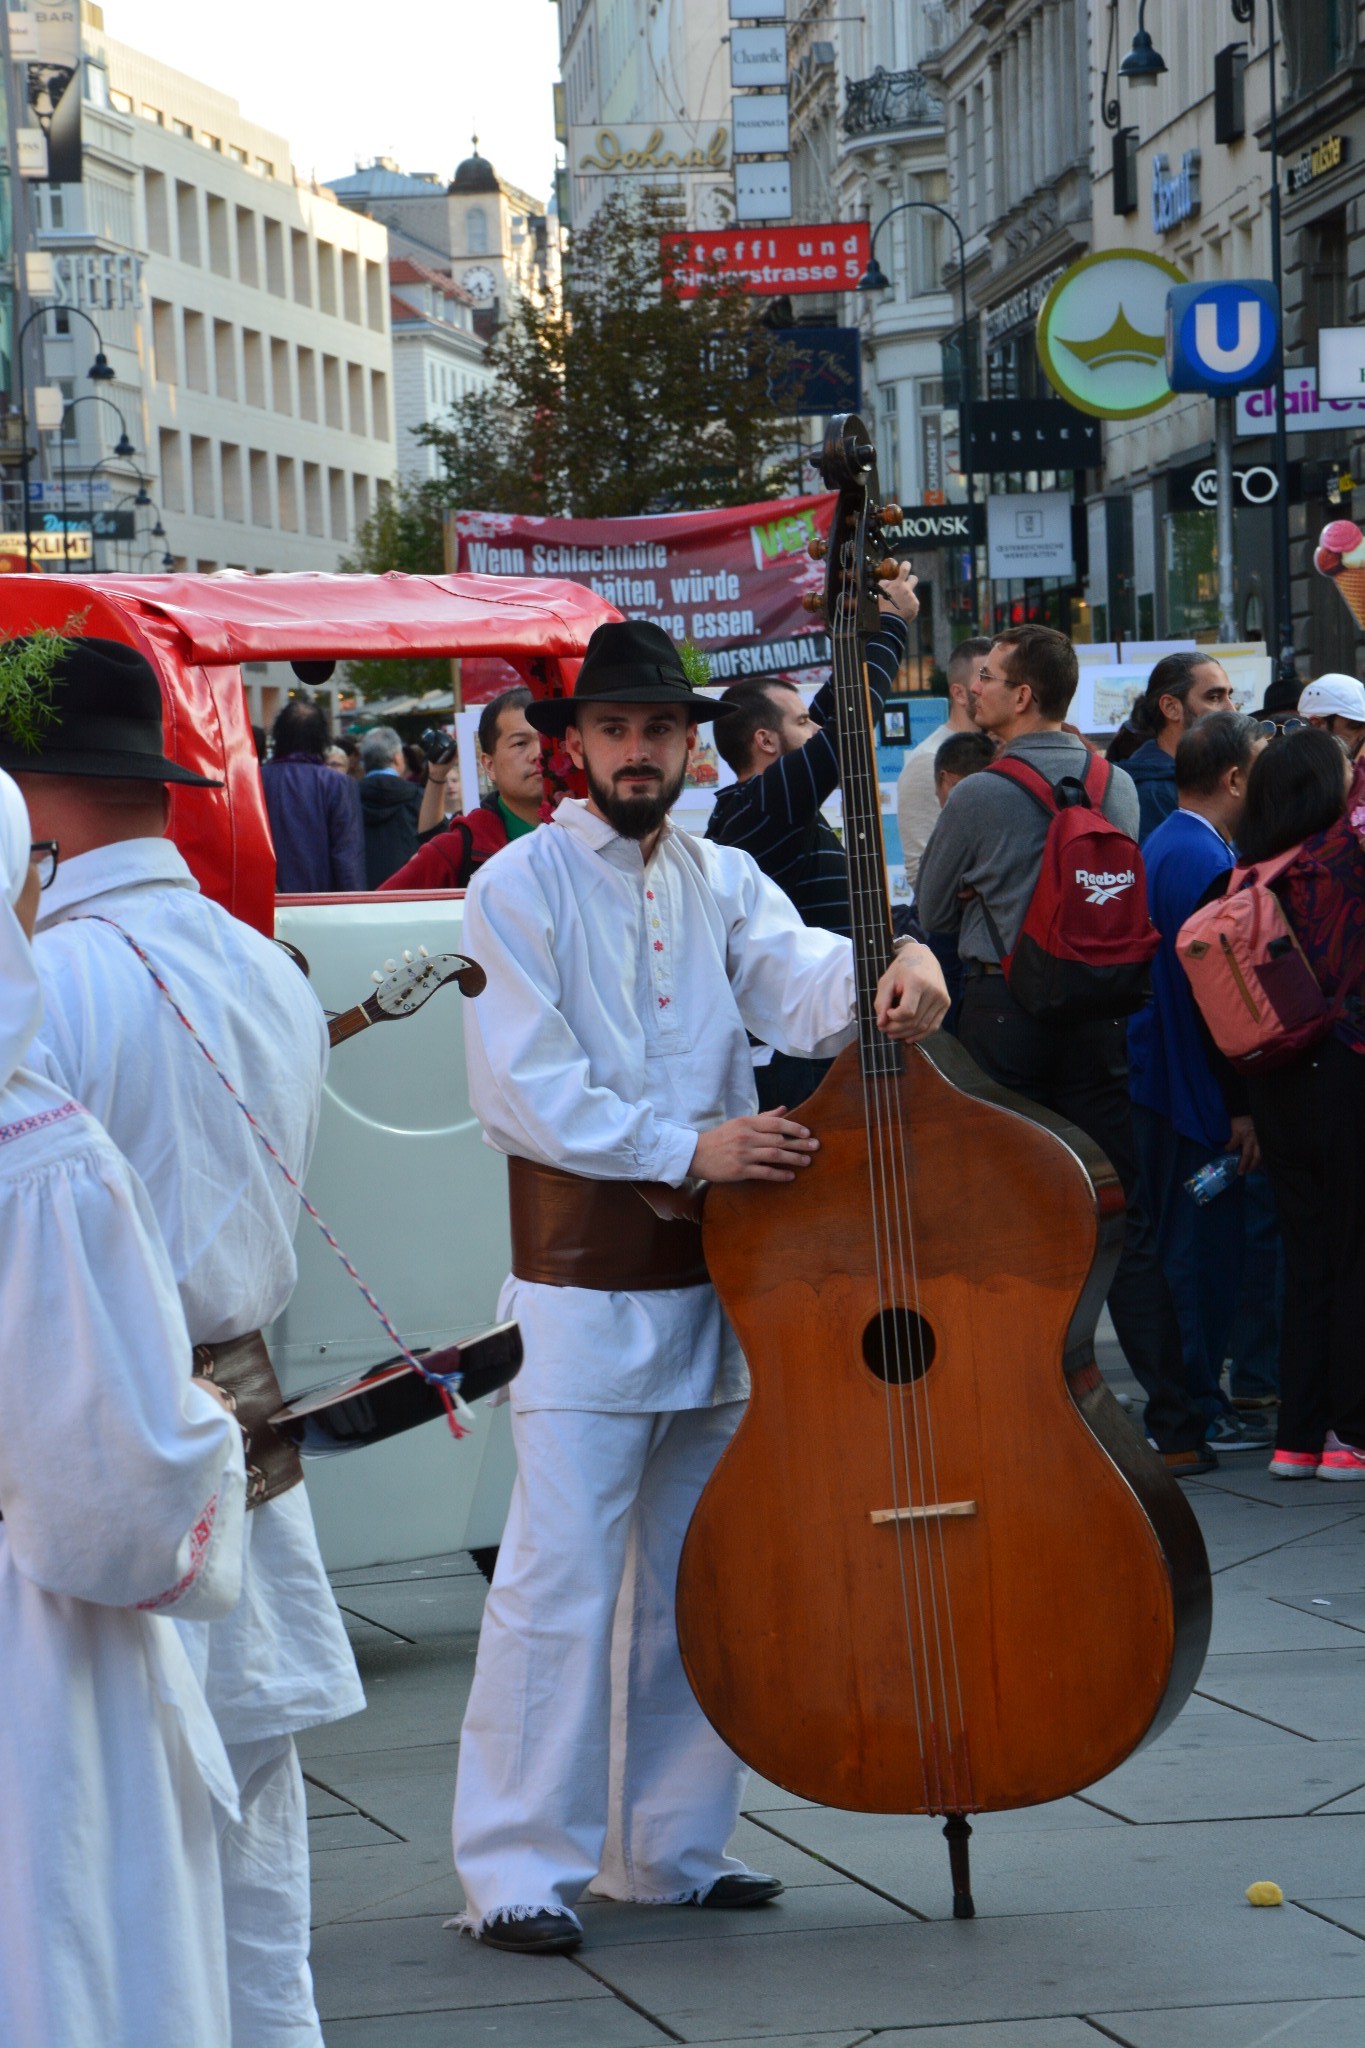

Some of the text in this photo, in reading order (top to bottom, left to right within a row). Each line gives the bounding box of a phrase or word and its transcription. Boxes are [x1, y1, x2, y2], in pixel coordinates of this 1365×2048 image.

[36, 12, 73, 22] BAR
[733, 47, 783, 64] Chantelle
[736, 120, 786, 128] PASSIONATA
[738, 186, 788, 195] FALKE
[798, 236, 858, 257] und
[846, 259, 859, 279] 5
[52, 255, 144, 309] STEFFL
[1195, 301, 1260, 373] U
[880, 516, 969, 538] AROVSK
[468, 541, 668, 574] Wenn Schlachthöfe
[591, 569, 741, 609] hätten, würde
[692, 609, 761, 639] essen.
[707, 636, 832, 679] HOFSKANDAL.
[1076, 870, 1135, 886] Reebok
